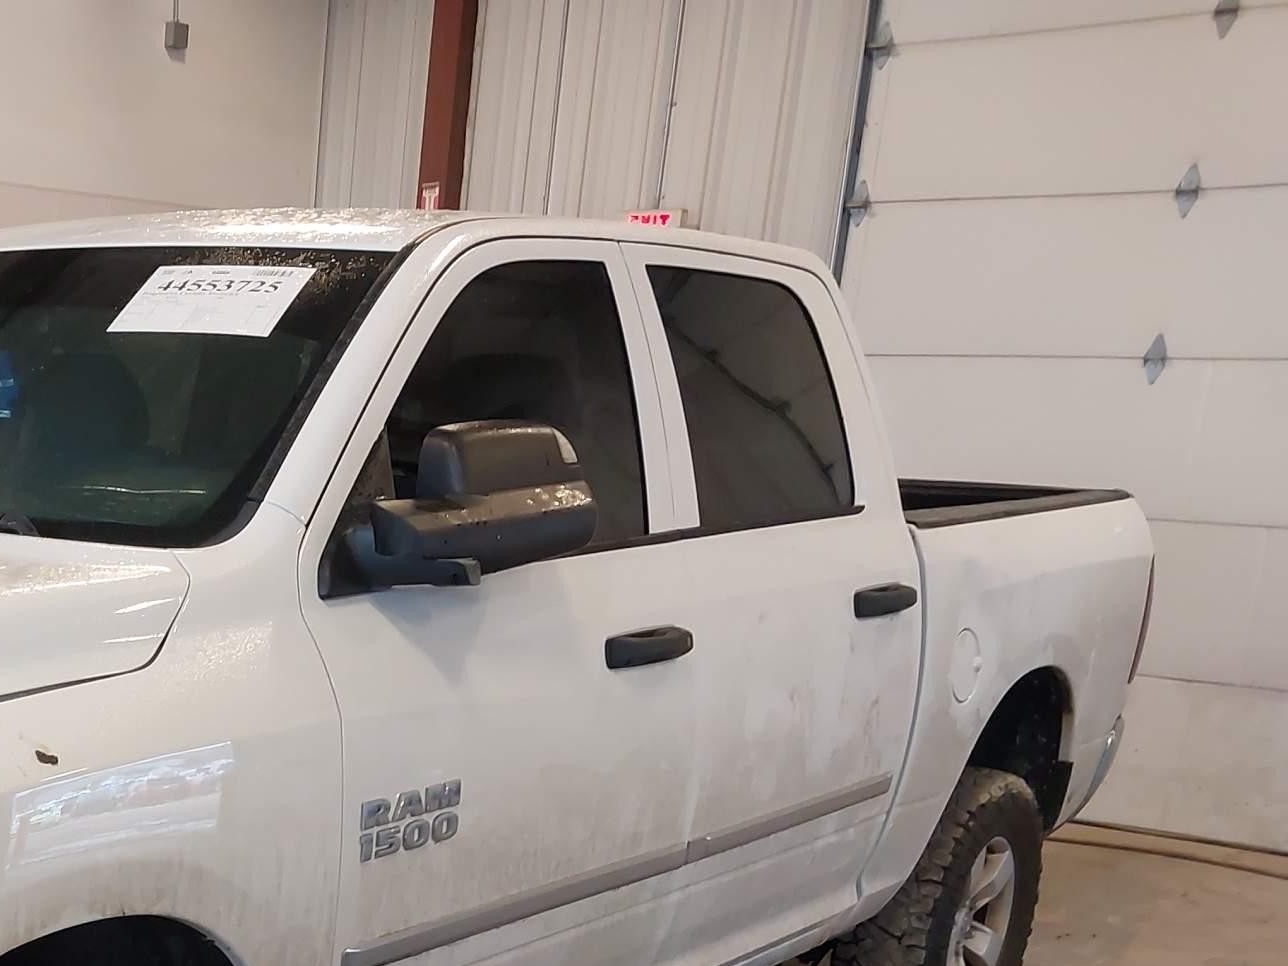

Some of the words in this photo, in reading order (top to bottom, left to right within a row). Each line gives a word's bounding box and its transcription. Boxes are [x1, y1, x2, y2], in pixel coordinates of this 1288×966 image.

[158, 279, 283, 293] 44553725
[360, 778, 462, 831] RAM
[359, 811, 460, 864] 1500
